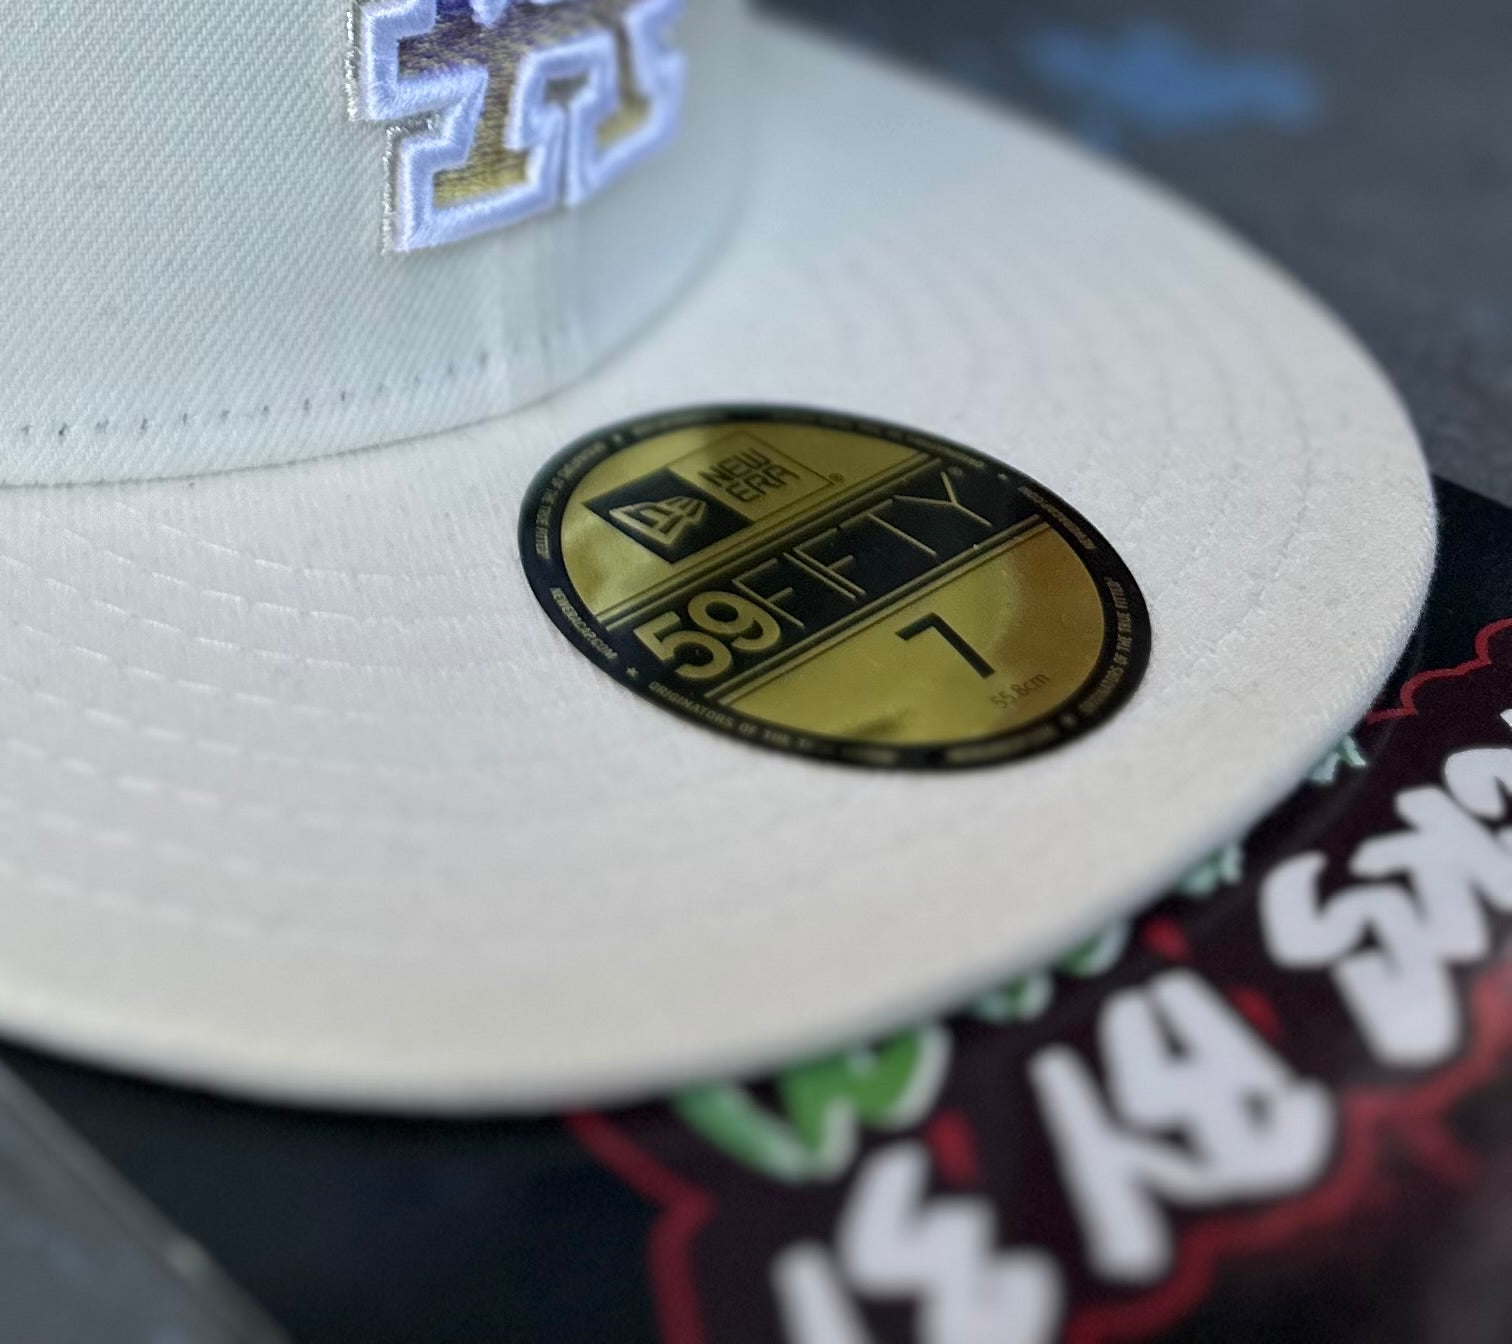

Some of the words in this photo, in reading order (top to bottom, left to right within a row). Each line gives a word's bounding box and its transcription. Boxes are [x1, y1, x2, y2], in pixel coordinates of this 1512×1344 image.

[697, 447, 772, 488] NEW
[724, 462, 801, 503] ERA
[632, 470, 992, 680] 59FIFTY
[894, 612, 996, 679] 7
[990, 672, 1051, 709] 55.8cm
